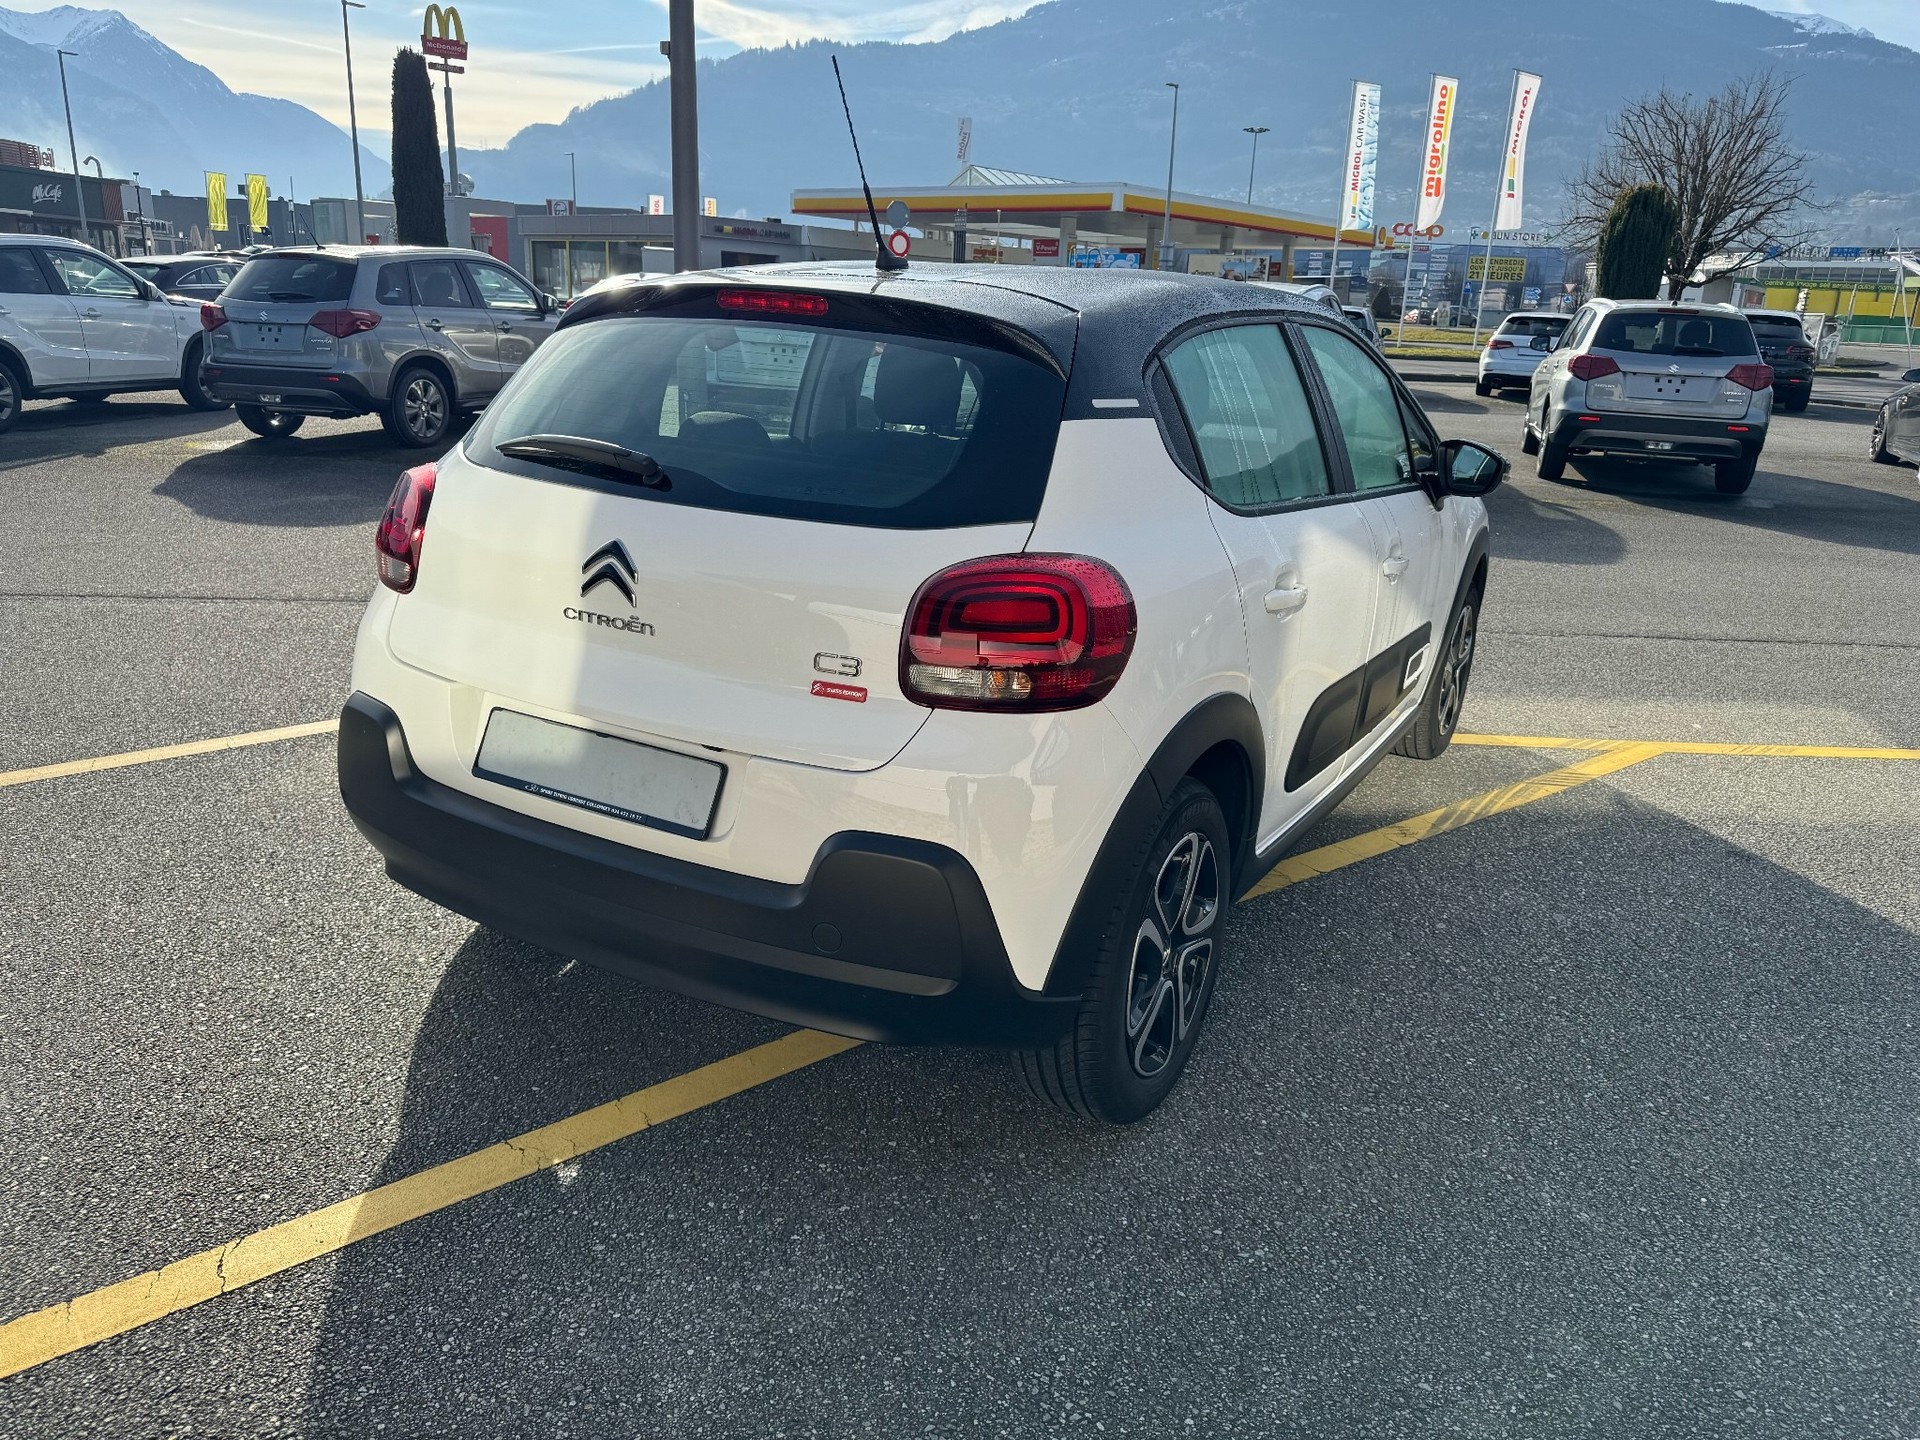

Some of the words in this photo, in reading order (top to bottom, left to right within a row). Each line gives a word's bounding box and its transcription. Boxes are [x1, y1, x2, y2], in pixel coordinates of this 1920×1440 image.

[426, 41, 466, 53] McDonald's
[1358, 93, 1367, 125] WASH
[1511, 87, 1531, 155] MIGROL
[1355, 127, 1364, 148] CAR
[1425, 85, 1448, 197] migrolino
[1351, 150, 1362, 191] MIGROL
[1512, 232, 1541, 241] STORE
[1469, 271, 1480, 279] 21
[563, 607, 656, 636] CITROËN
[813, 651, 863, 677] C3
